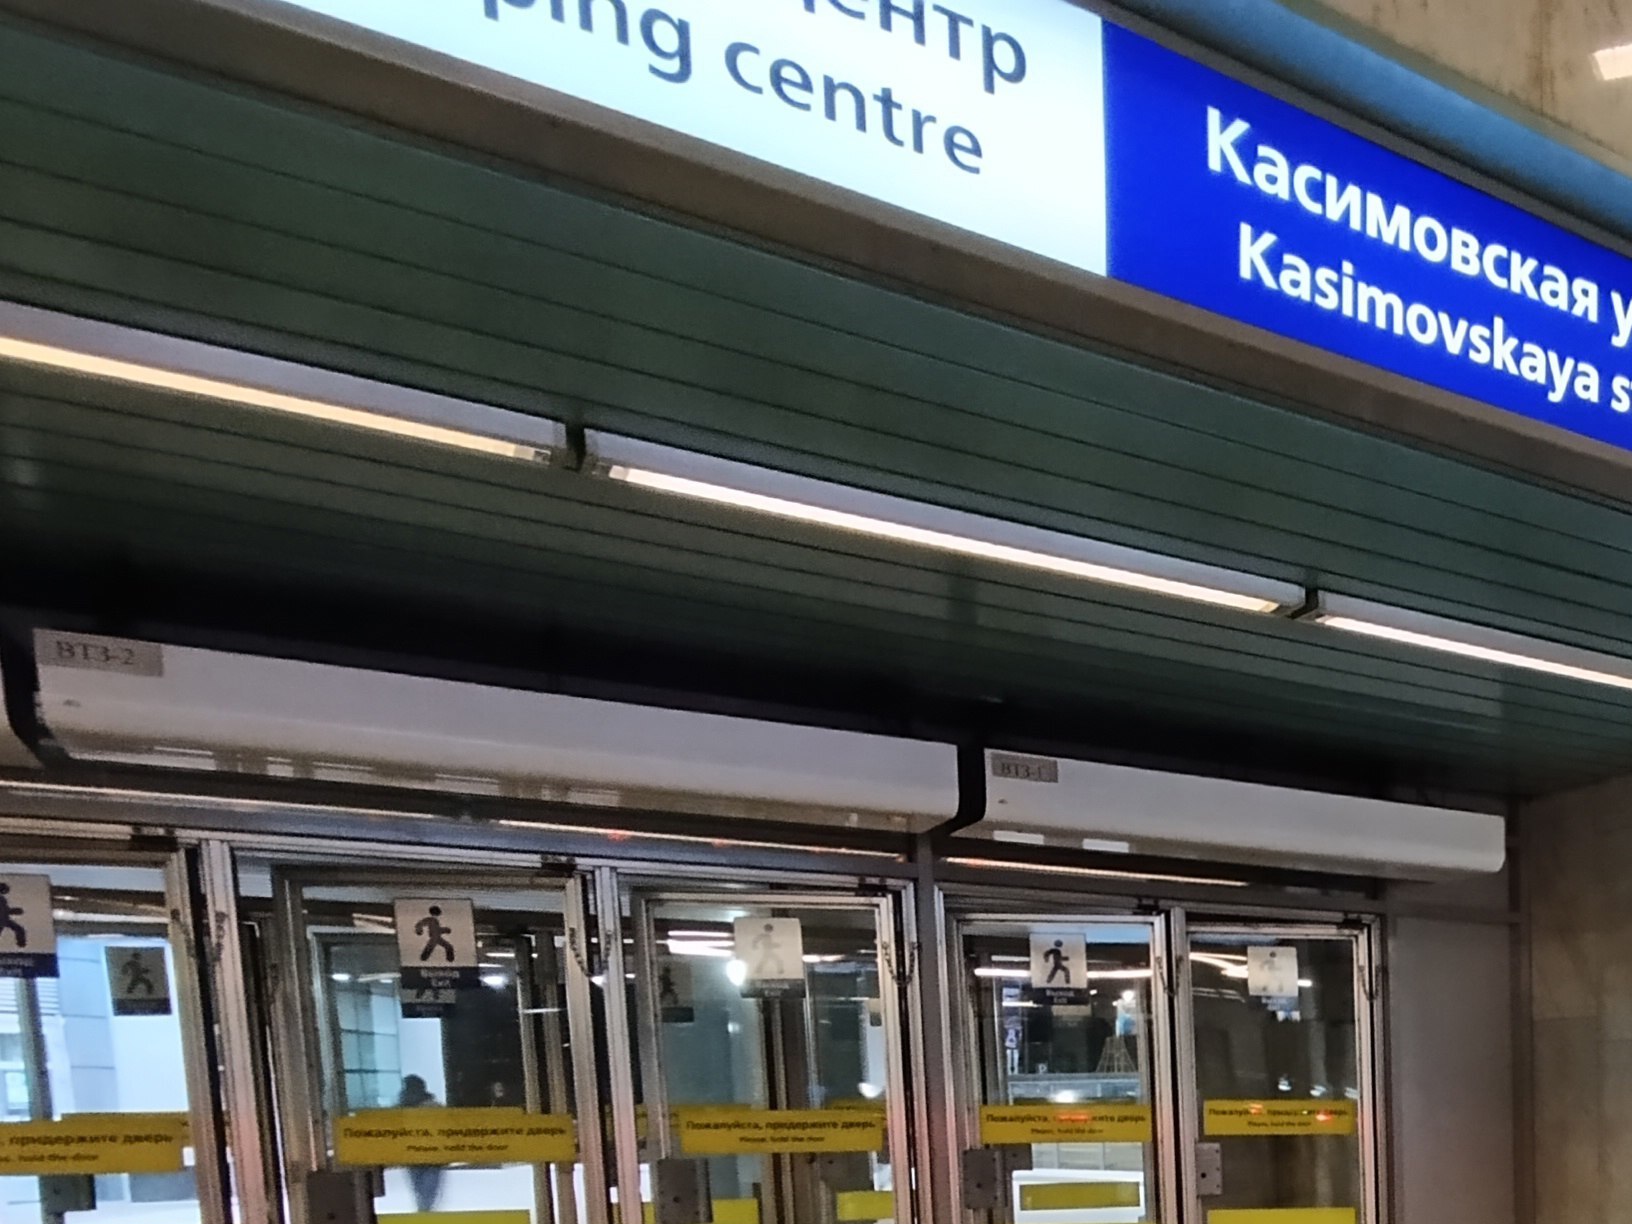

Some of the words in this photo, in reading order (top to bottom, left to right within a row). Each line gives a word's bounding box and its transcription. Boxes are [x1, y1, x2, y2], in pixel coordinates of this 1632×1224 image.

[803, 0, 1027, 95] нтр
[725, 42, 983, 174] centre
[1206, 105, 1600, 325] Касимовская
[1238, 221, 1601, 405] Kasimovskaya
[8, 1133, 118, 1147] придержите
[122, 1132, 174, 1146] дверь
[343, 1127, 433, 1140] Пожалуйста,
[437, 1126, 524, 1139] придержите
[526, 1125, 567, 1137] дверь
[686, 1119, 763, 1131] Пожалуйста,
[765, 1120, 839, 1132] придержите
[841, 1119, 876, 1131] дверь
